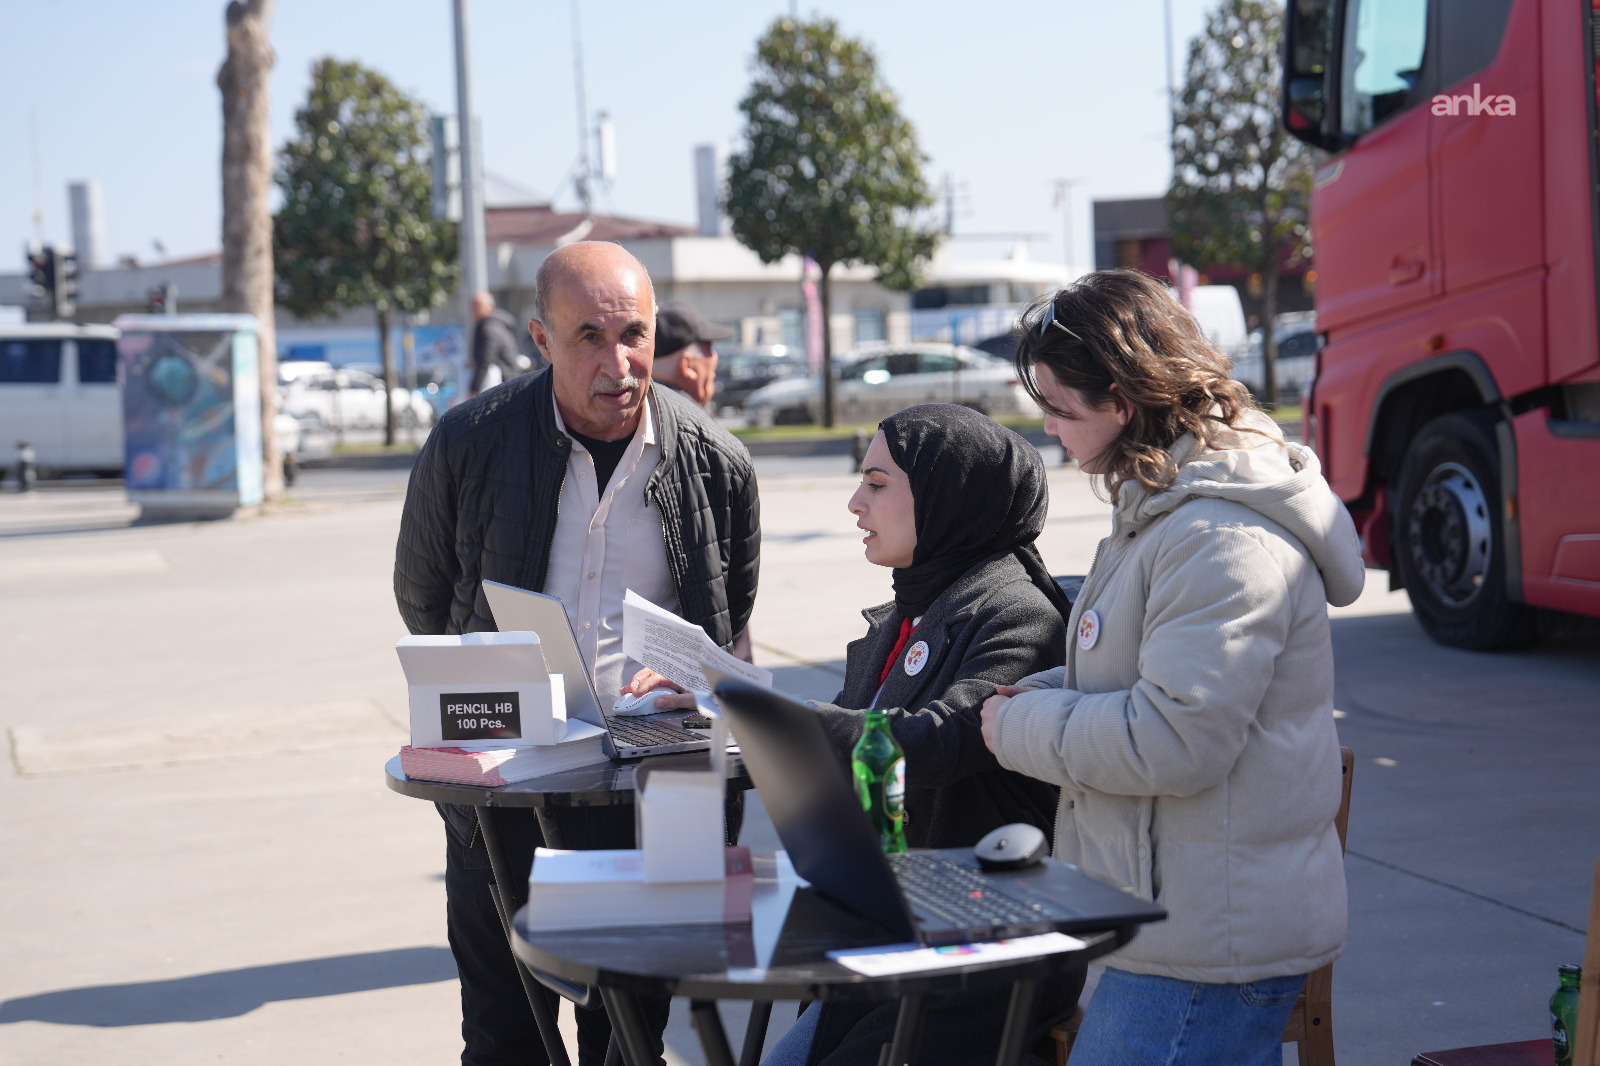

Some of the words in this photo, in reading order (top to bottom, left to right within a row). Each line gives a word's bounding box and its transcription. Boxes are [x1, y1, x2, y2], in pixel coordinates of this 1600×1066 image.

[448, 704, 492, 714] PENCIL
[495, 702, 512, 714] HB
[456, 718, 476, 728] 100
[480, 718, 506, 728] Pcs.
